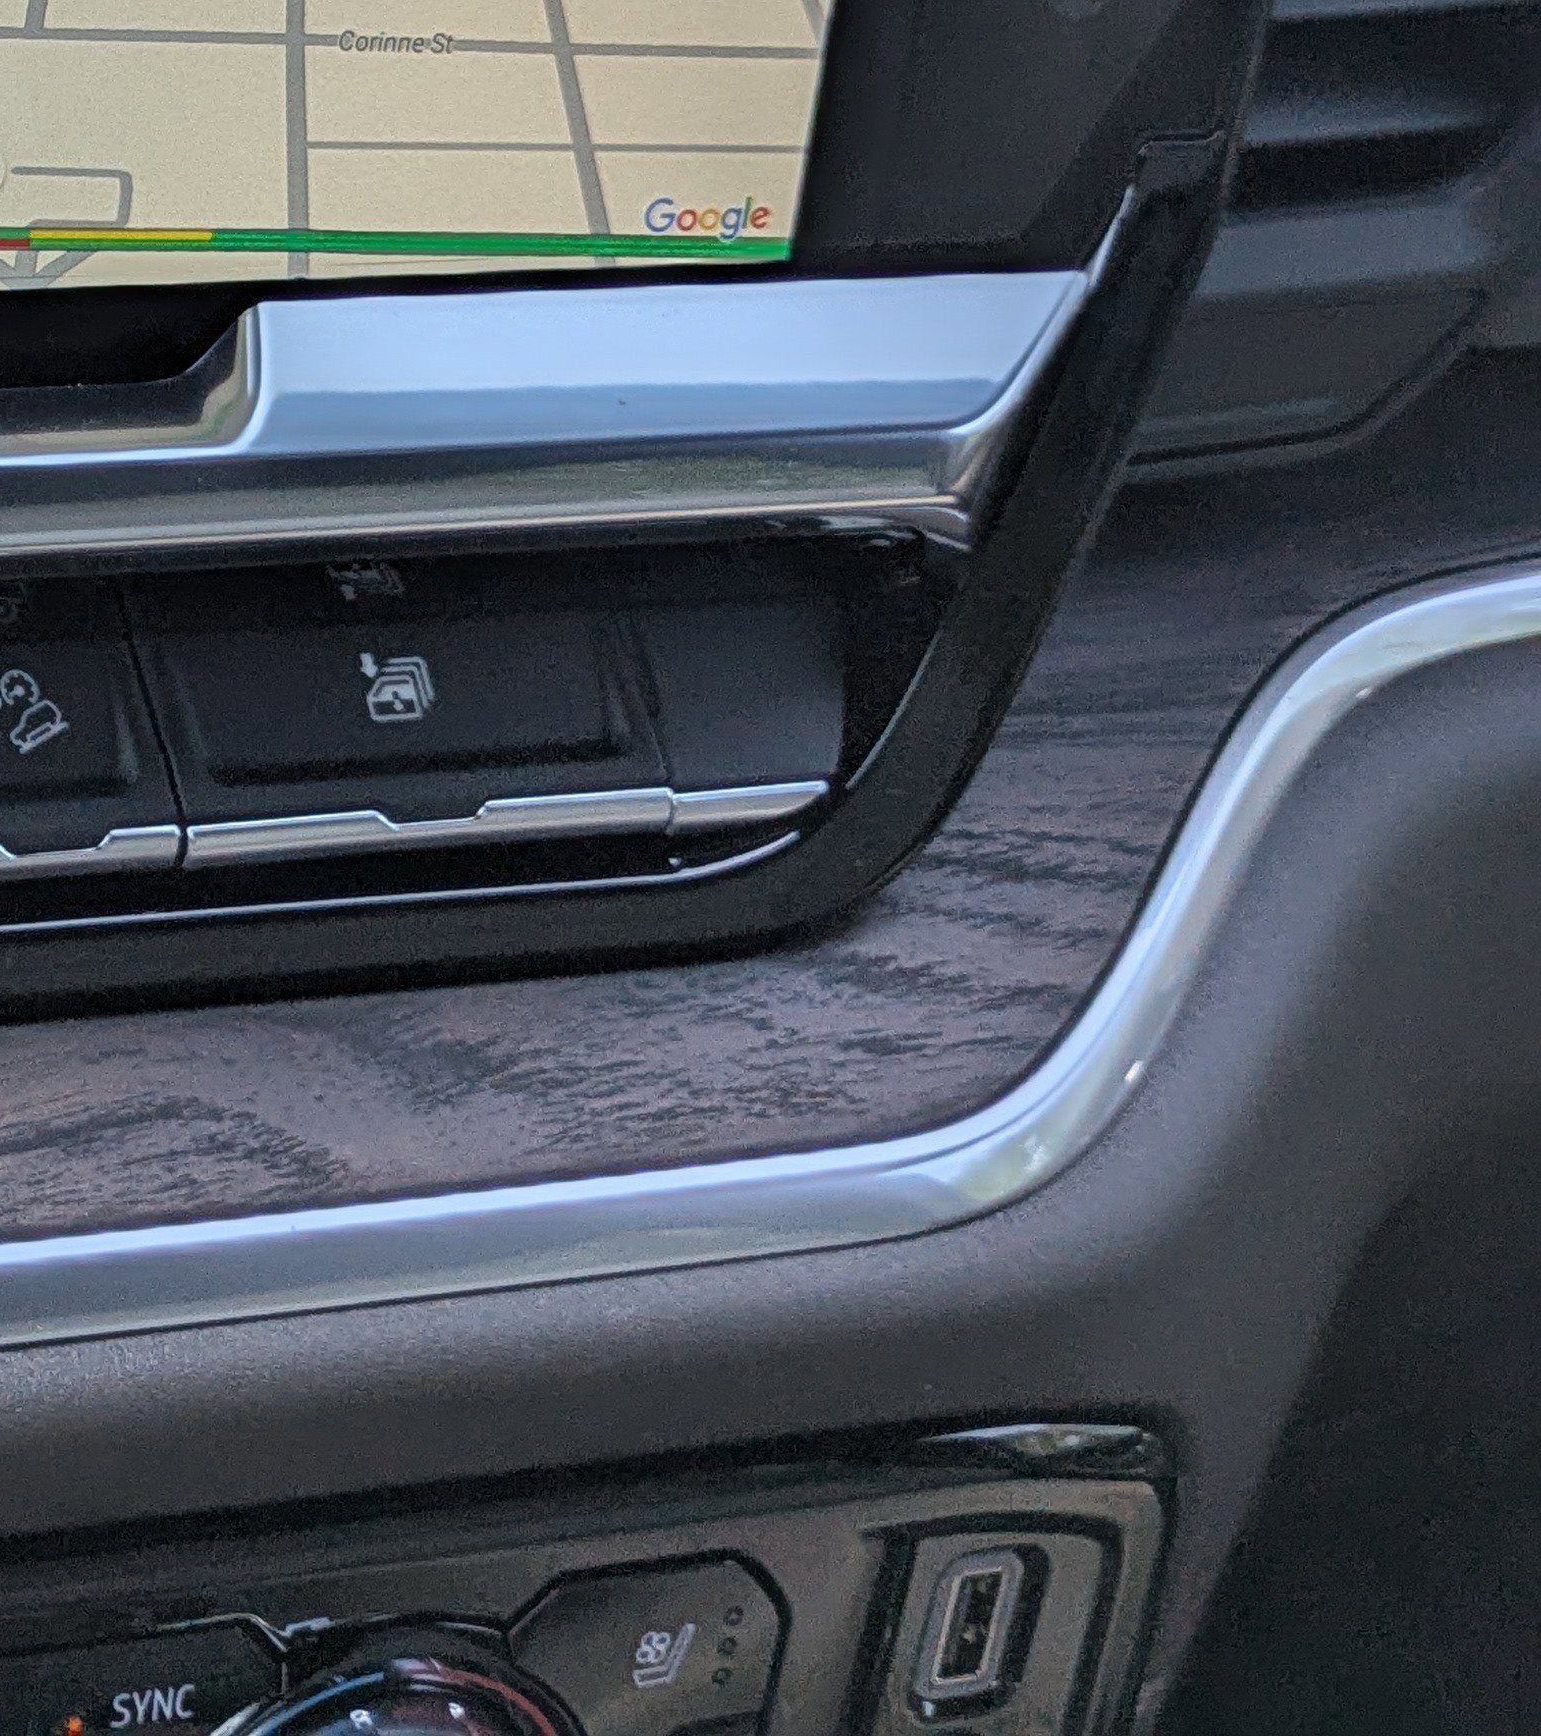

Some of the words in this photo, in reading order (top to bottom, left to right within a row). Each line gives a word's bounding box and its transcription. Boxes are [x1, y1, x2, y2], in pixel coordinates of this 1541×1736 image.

[338, 32, 425, 54] Corinne
[431, 33, 454, 54] St
[644, 197, 770, 240] Google
[110, 1683, 196, 1729] SYNC
